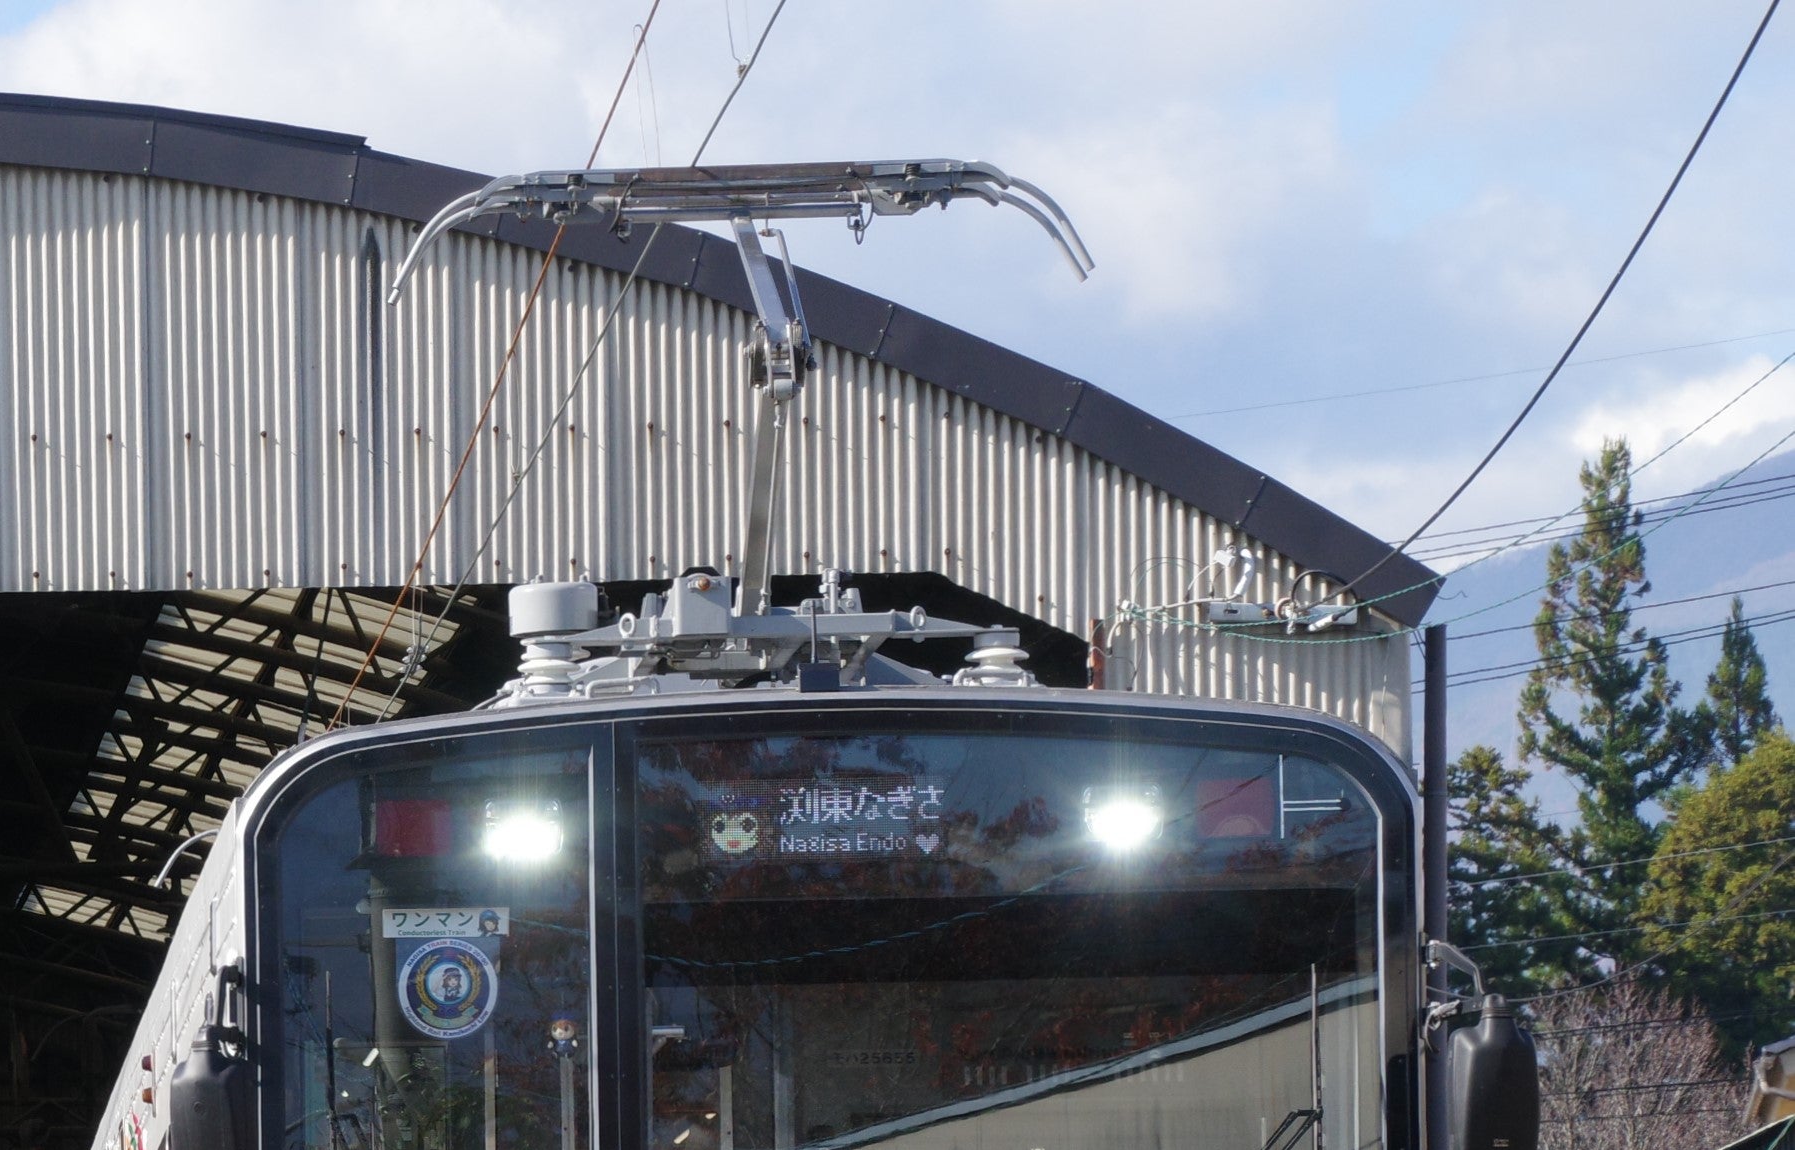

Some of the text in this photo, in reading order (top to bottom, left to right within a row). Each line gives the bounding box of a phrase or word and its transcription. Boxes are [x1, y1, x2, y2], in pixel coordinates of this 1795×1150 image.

[779, 784, 945, 825] 渕東なぎさ
[780, 832, 906, 853] Nagisa Endo
[391, 911, 474, 928] ワンマン
